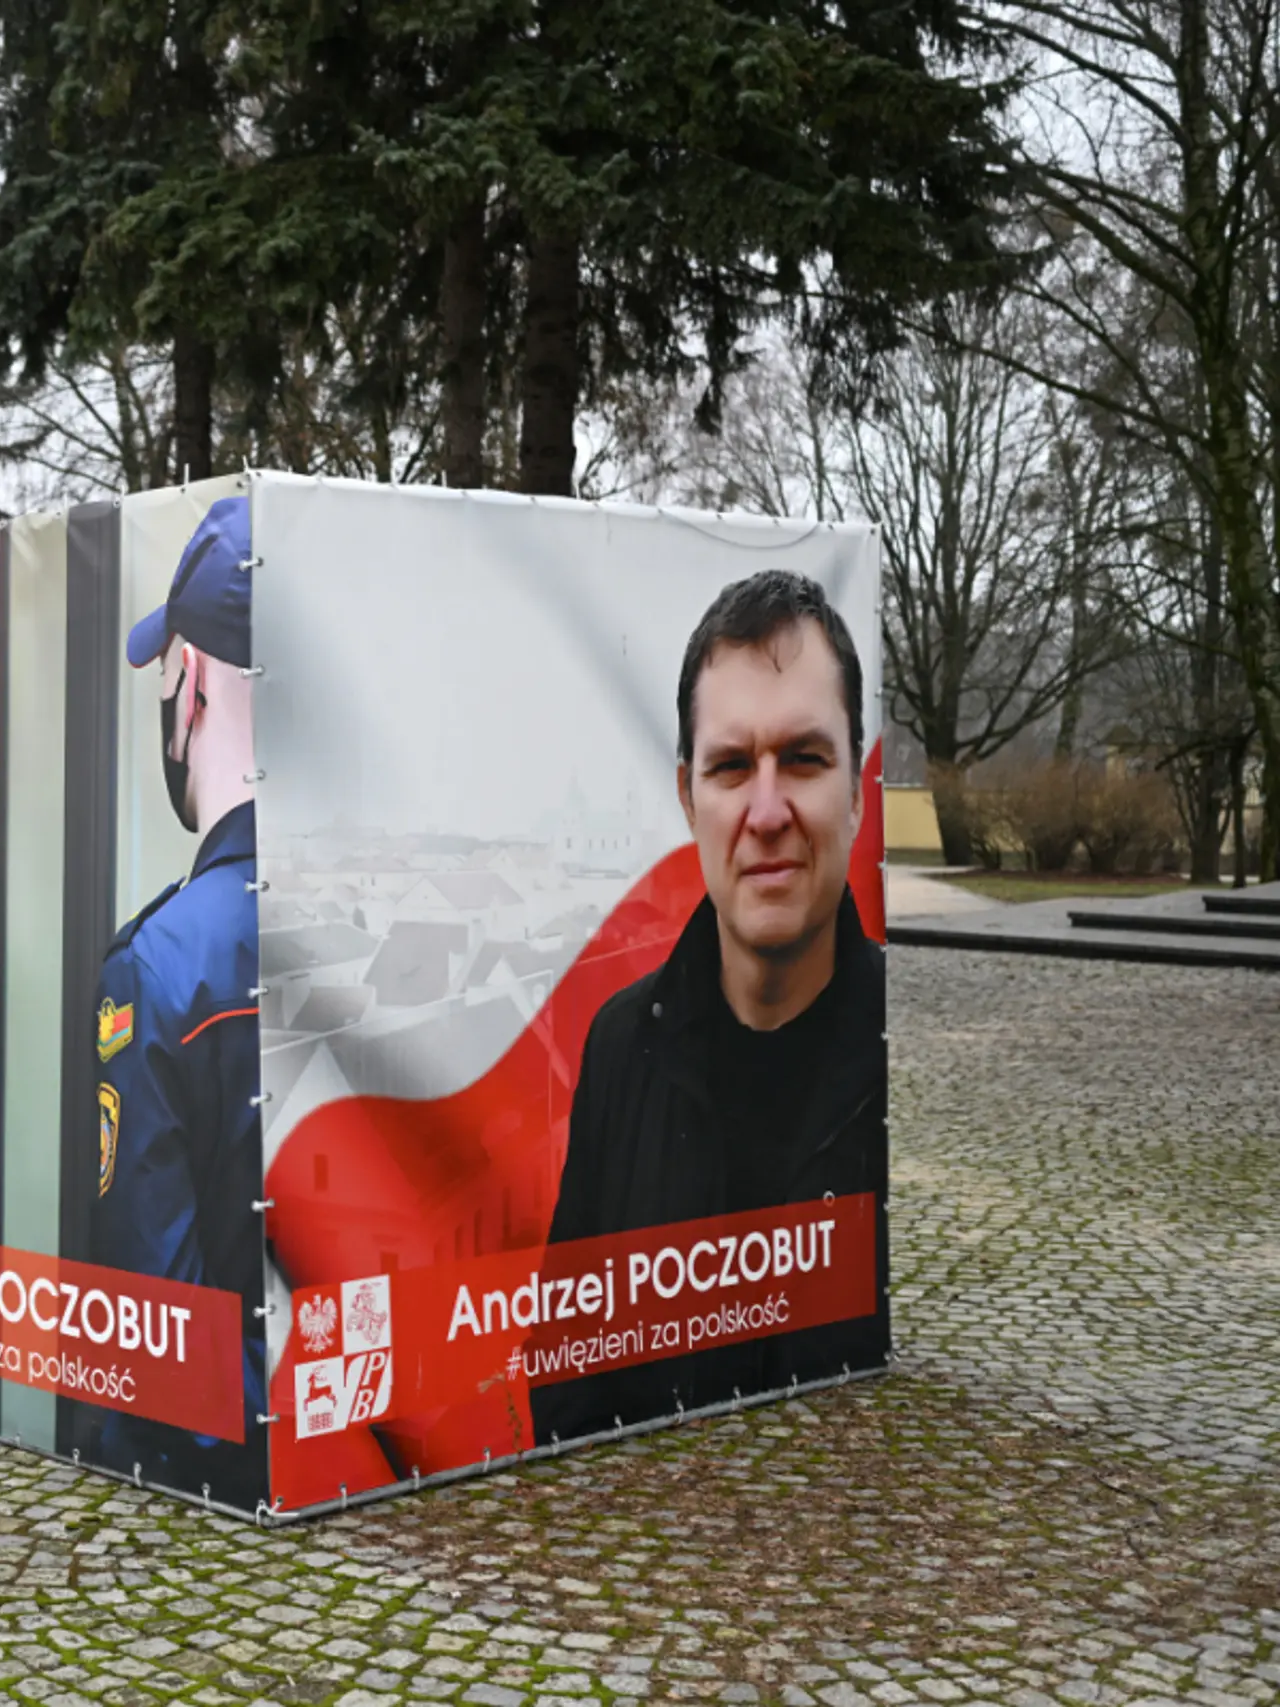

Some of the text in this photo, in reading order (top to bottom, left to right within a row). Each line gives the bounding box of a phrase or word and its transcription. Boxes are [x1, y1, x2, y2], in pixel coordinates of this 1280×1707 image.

[447, 1219, 835, 1341] Andrzej POCZOBUT
[27, 1351, 136, 1403] polskość
[505, 1291, 790, 1380] #uwięzieni za polskość
